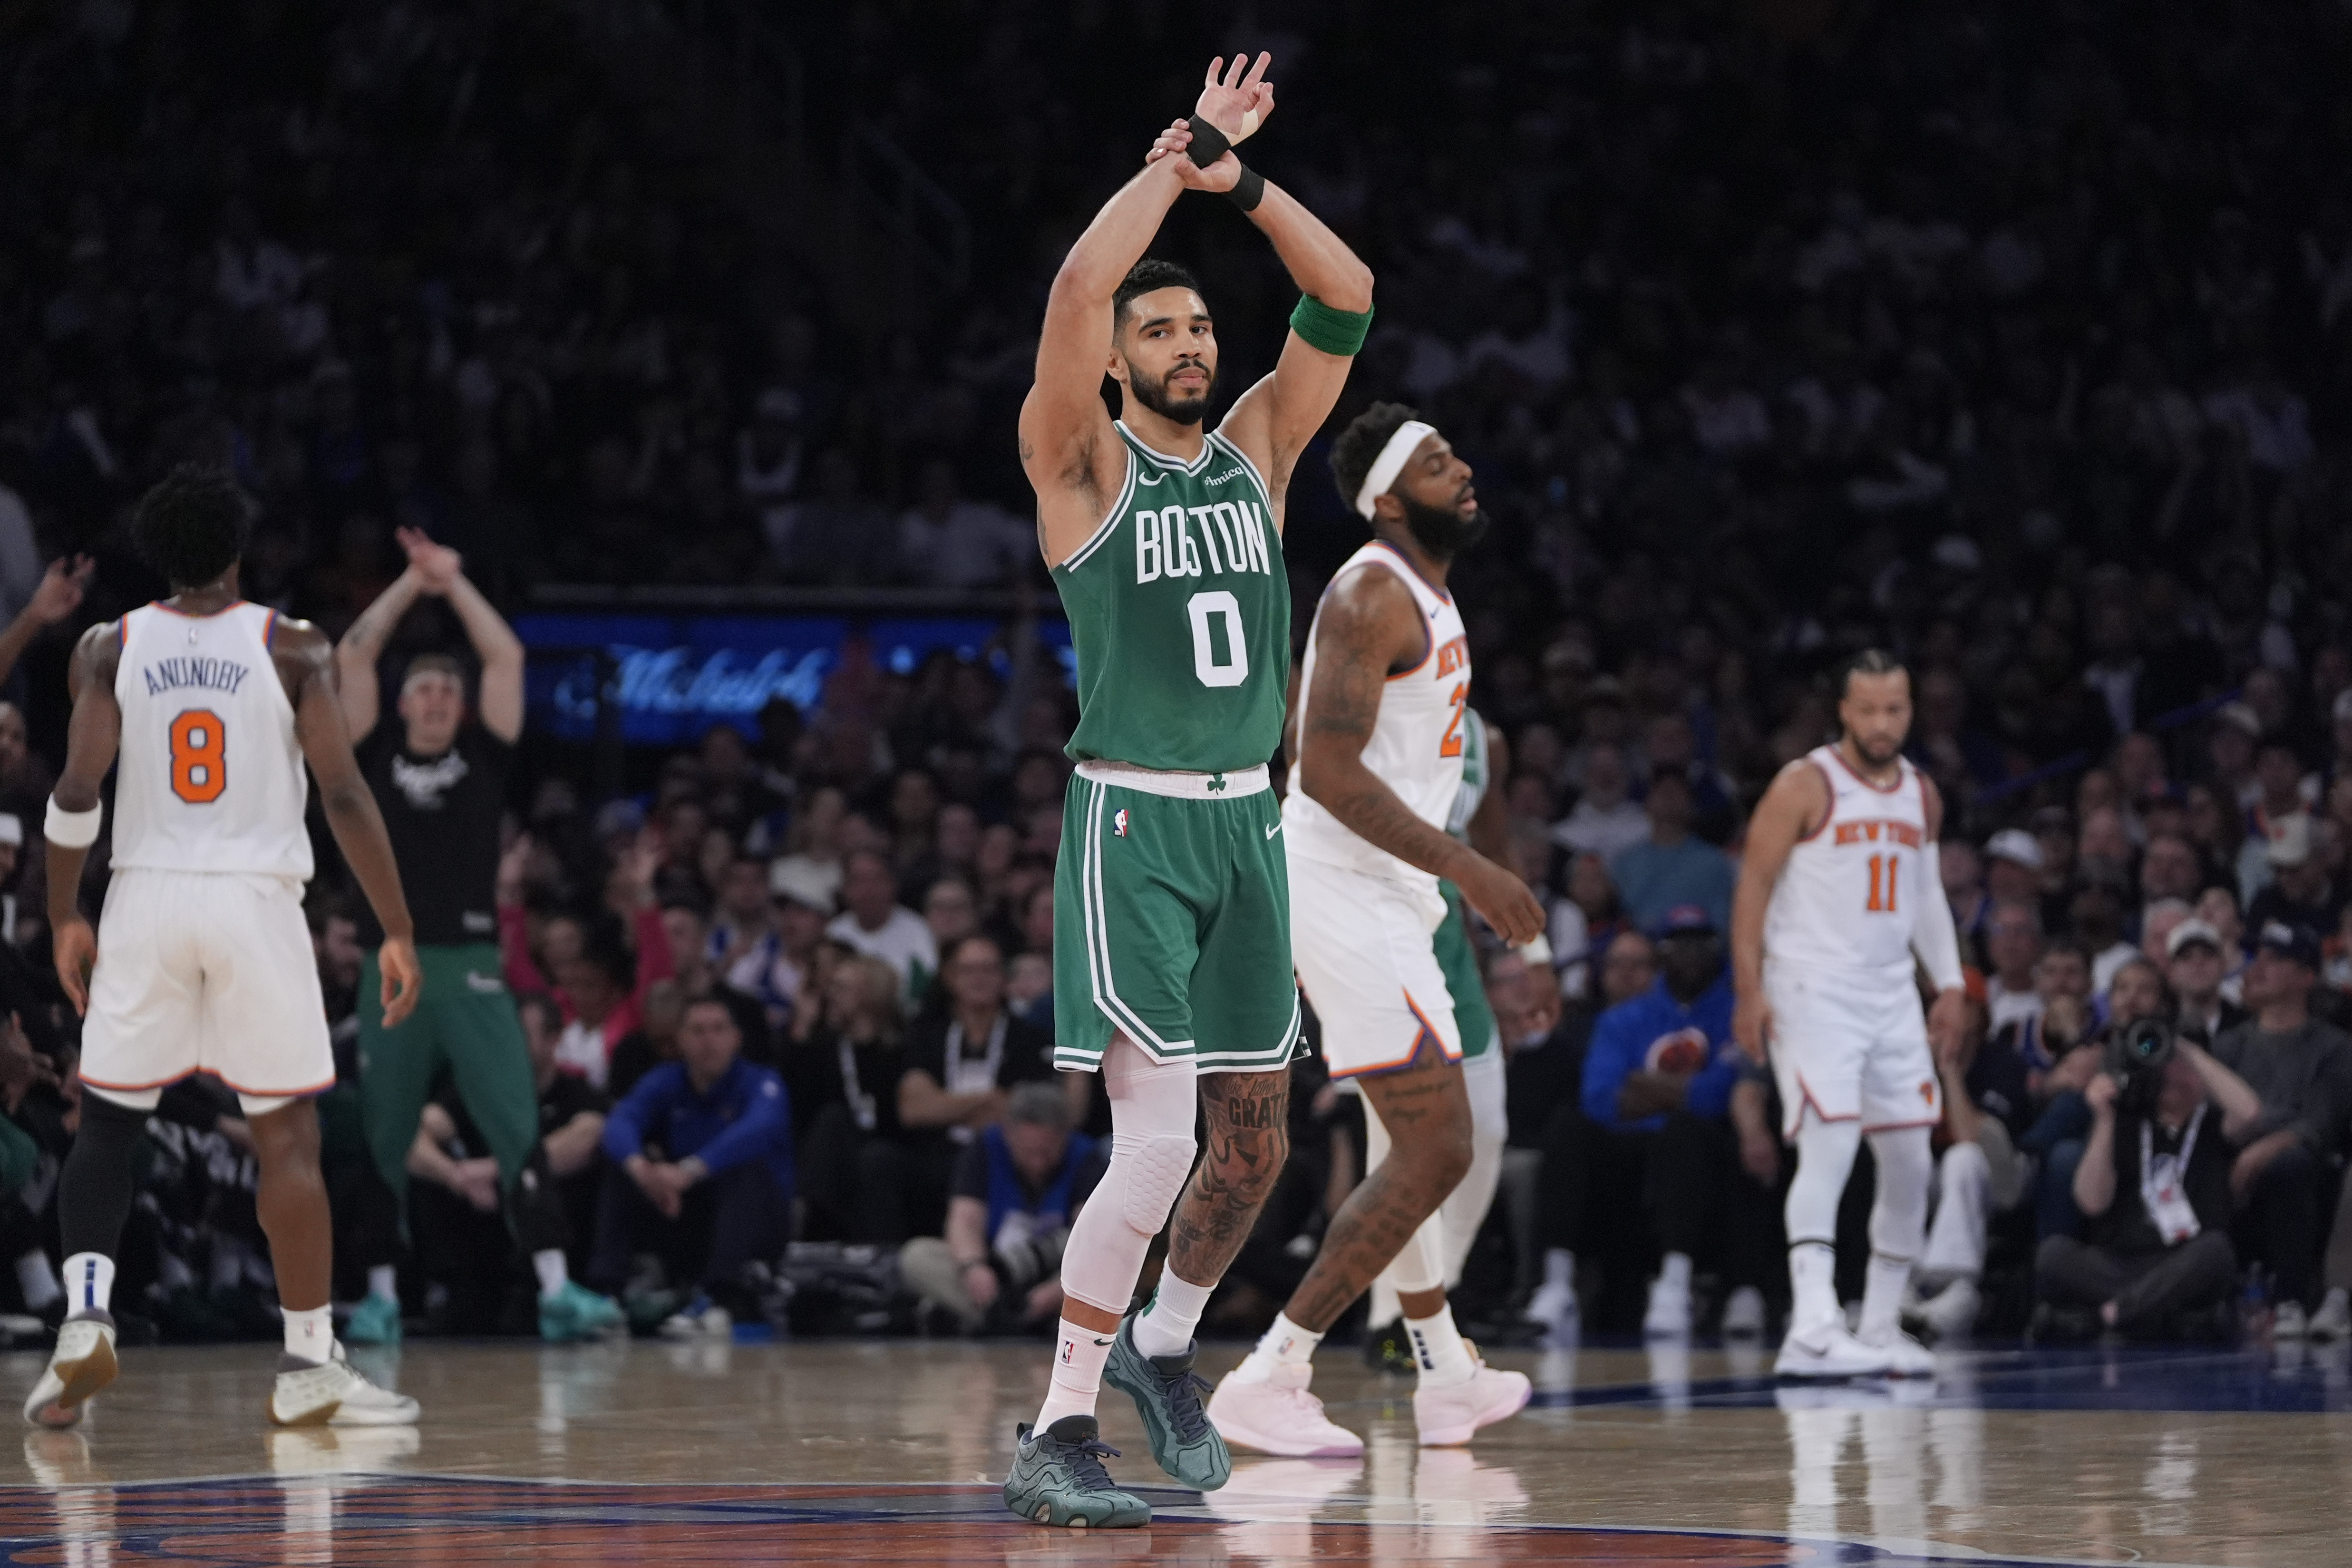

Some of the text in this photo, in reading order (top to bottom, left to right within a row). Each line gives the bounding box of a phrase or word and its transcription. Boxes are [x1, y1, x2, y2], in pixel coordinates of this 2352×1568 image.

[1205, 467, 1244, 486] Amica
[1136, 500, 1270, 584] BOSTON
[1187, 591, 1248, 687] 0
[144, 656, 249, 696] ANUNOBY
[169, 708, 226, 804] 8
[1866, 855, 1899, 912] 11
